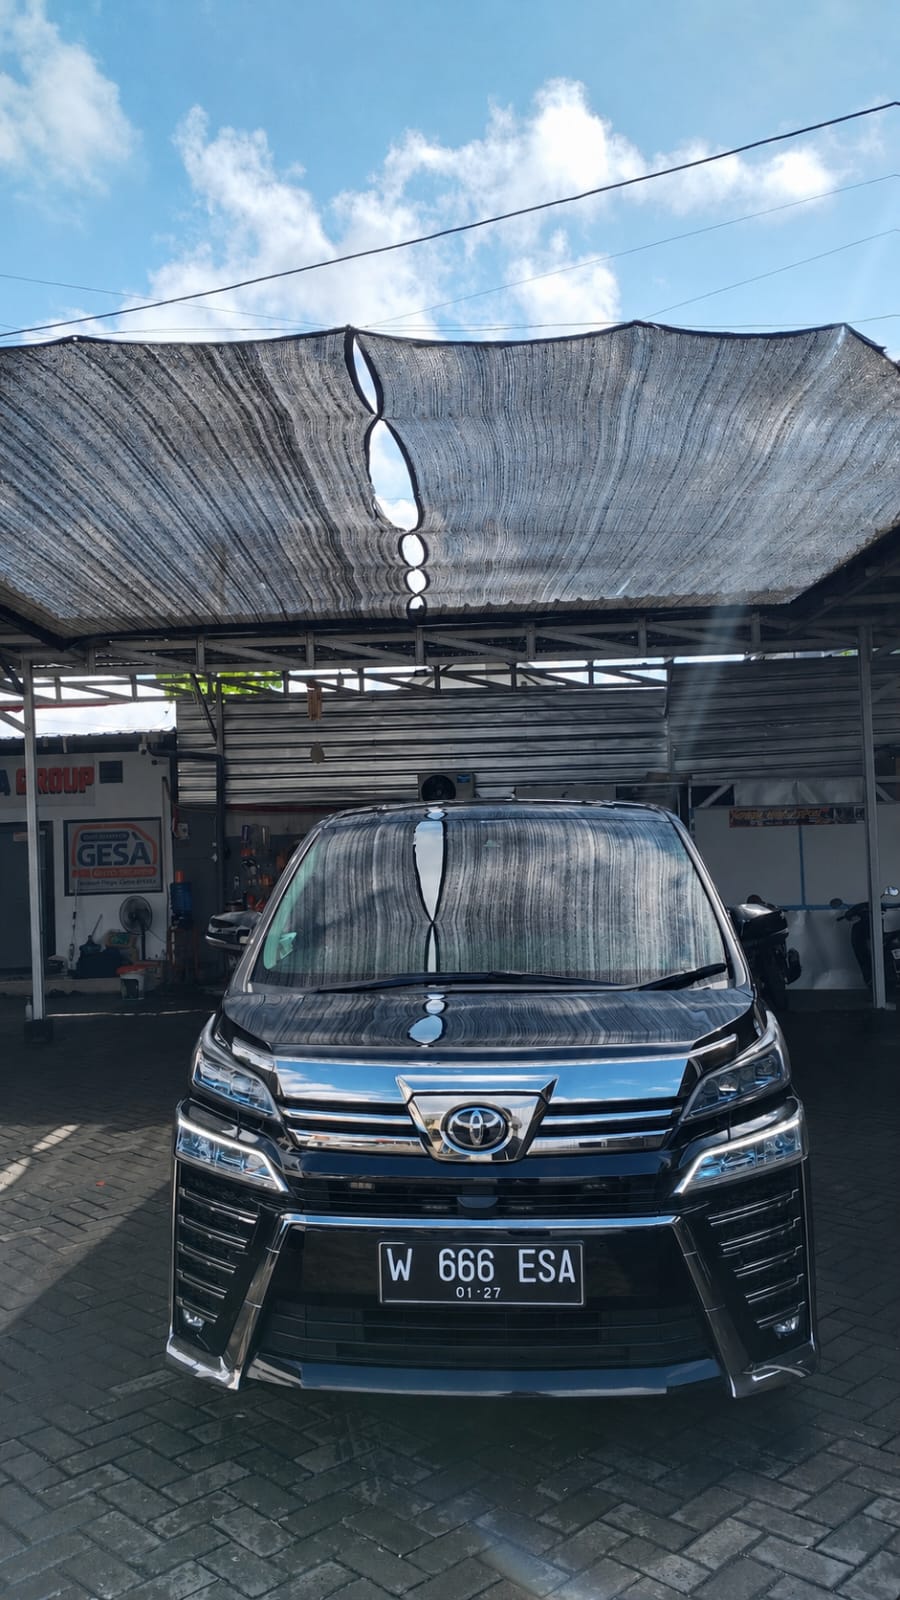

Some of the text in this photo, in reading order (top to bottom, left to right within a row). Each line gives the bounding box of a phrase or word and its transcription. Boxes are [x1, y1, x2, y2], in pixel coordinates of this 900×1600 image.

[16, 766, 94, 795] GROUP
[77, 842, 151, 866] GESA
[386, 1247, 576, 1283] W 666 ESA
